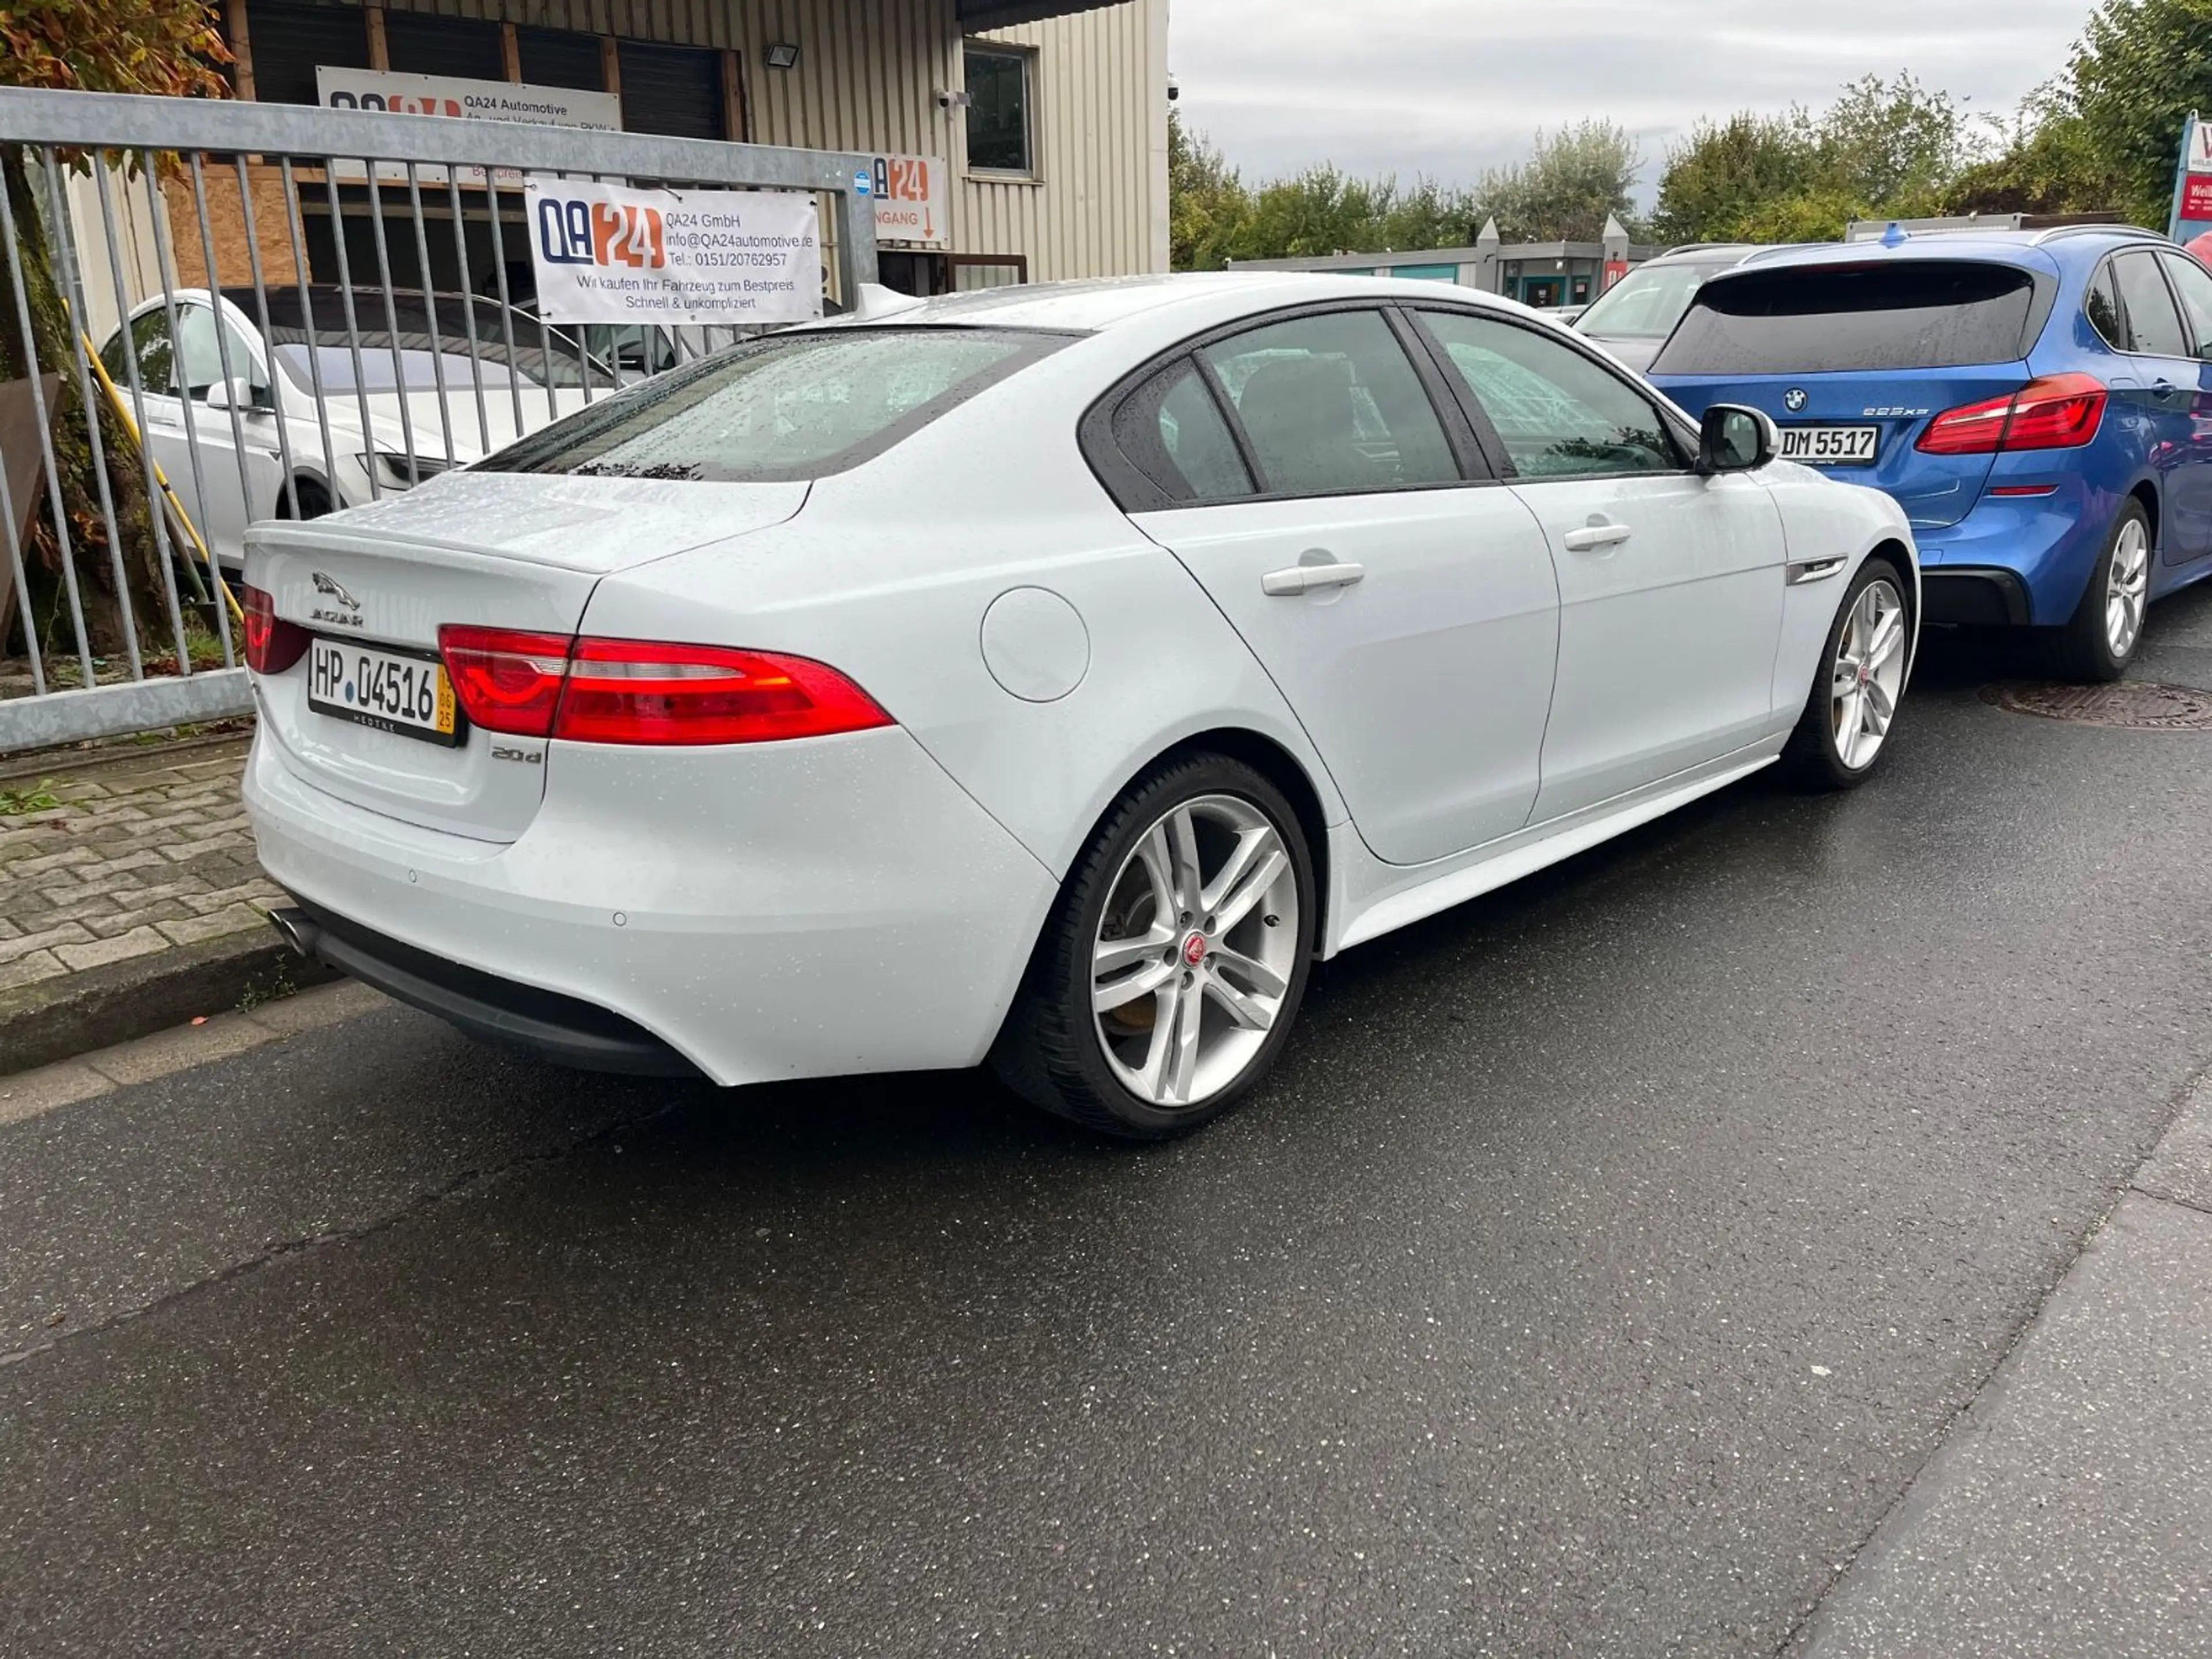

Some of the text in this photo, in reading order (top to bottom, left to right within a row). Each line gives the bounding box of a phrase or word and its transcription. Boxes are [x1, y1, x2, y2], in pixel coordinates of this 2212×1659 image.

[464, 96, 497, 109] QA24
[501, 100, 567, 115] Automotive
[873, 157, 929, 202] A24
[666, 213, 741, 229] QA24 GmbH
[874, 211, 918, 225] NGANG
[539, 199, 666, 268] QA24
[695, 252, 787, 267] 0151/20762957
[599, 276, 639, 290] kaufen
[643, 278, 658, 291] Ihr
[662, 279, 715, 294] Fahrzeug
[718, 281, 741, 291] zum
[744, 279, 794, 294] Bestpreis
[626, 296, 757, 312] Schnell & unkompliziert
[1815, 431, 1874, 455] 5517
[316, 647, 433, 721] HP 04516
